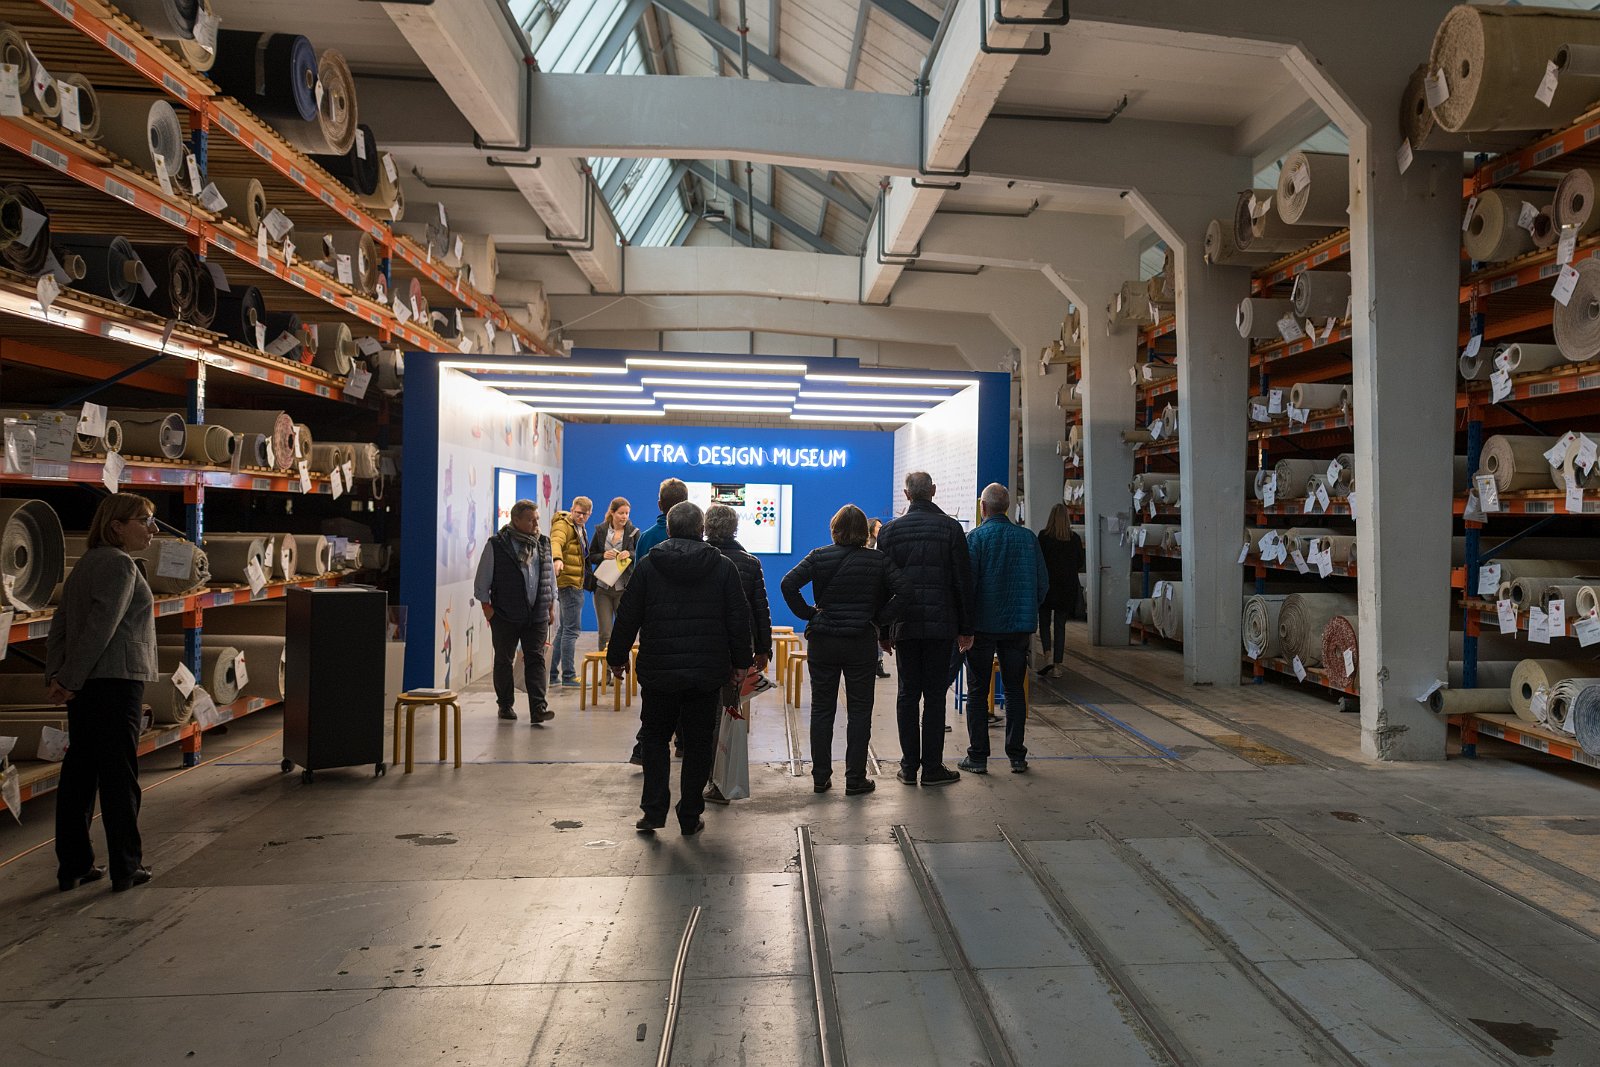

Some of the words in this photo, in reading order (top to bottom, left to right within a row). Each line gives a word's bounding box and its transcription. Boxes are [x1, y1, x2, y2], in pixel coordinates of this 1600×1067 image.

[625, 443, 688, 463] VITRA
[698, 445, 763, 466] DESIGN
[773, 447, 847, 468] MUSEUM
